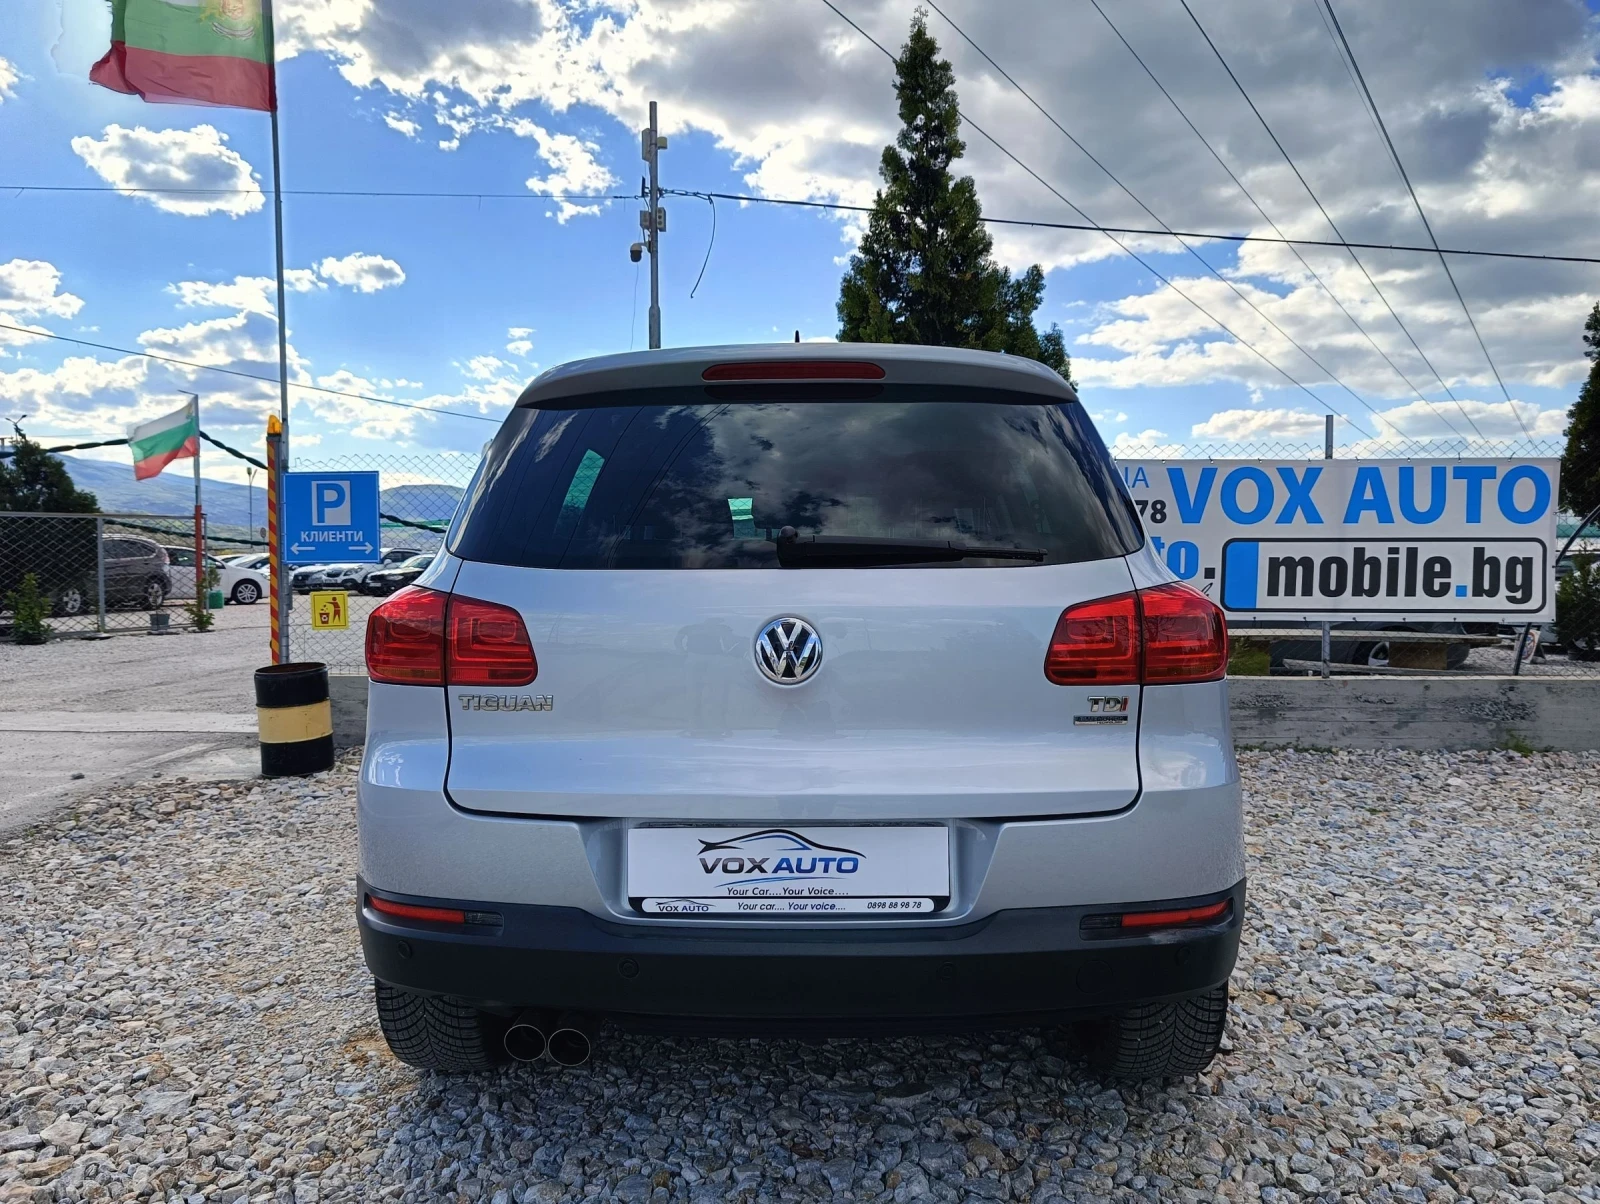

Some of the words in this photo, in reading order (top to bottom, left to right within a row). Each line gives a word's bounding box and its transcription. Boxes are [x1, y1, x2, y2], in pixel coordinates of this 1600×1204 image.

[316, 483, 346, 524] P
[1166, 466, 1324, 525] VOX
[1343, 465, 1551, 525] AUTO
[301, 530, 363, 542] КЛИЕНТИ
[1266, 546, 1534, 605] mobile.bg
[458, 694, 554, 712] TIGUAN
[1087, 695, 1130, 712] TDI
[727, 887, 749, 896] Your
[737, 902, 758, 911] Your
[788, 901, 808, 910] Your
[867, 901, 886, 909] 0898
[888, 901, 898, 909] 88
[900, 901, 910, 909] 98
[911, 901, 922, 909] 78
